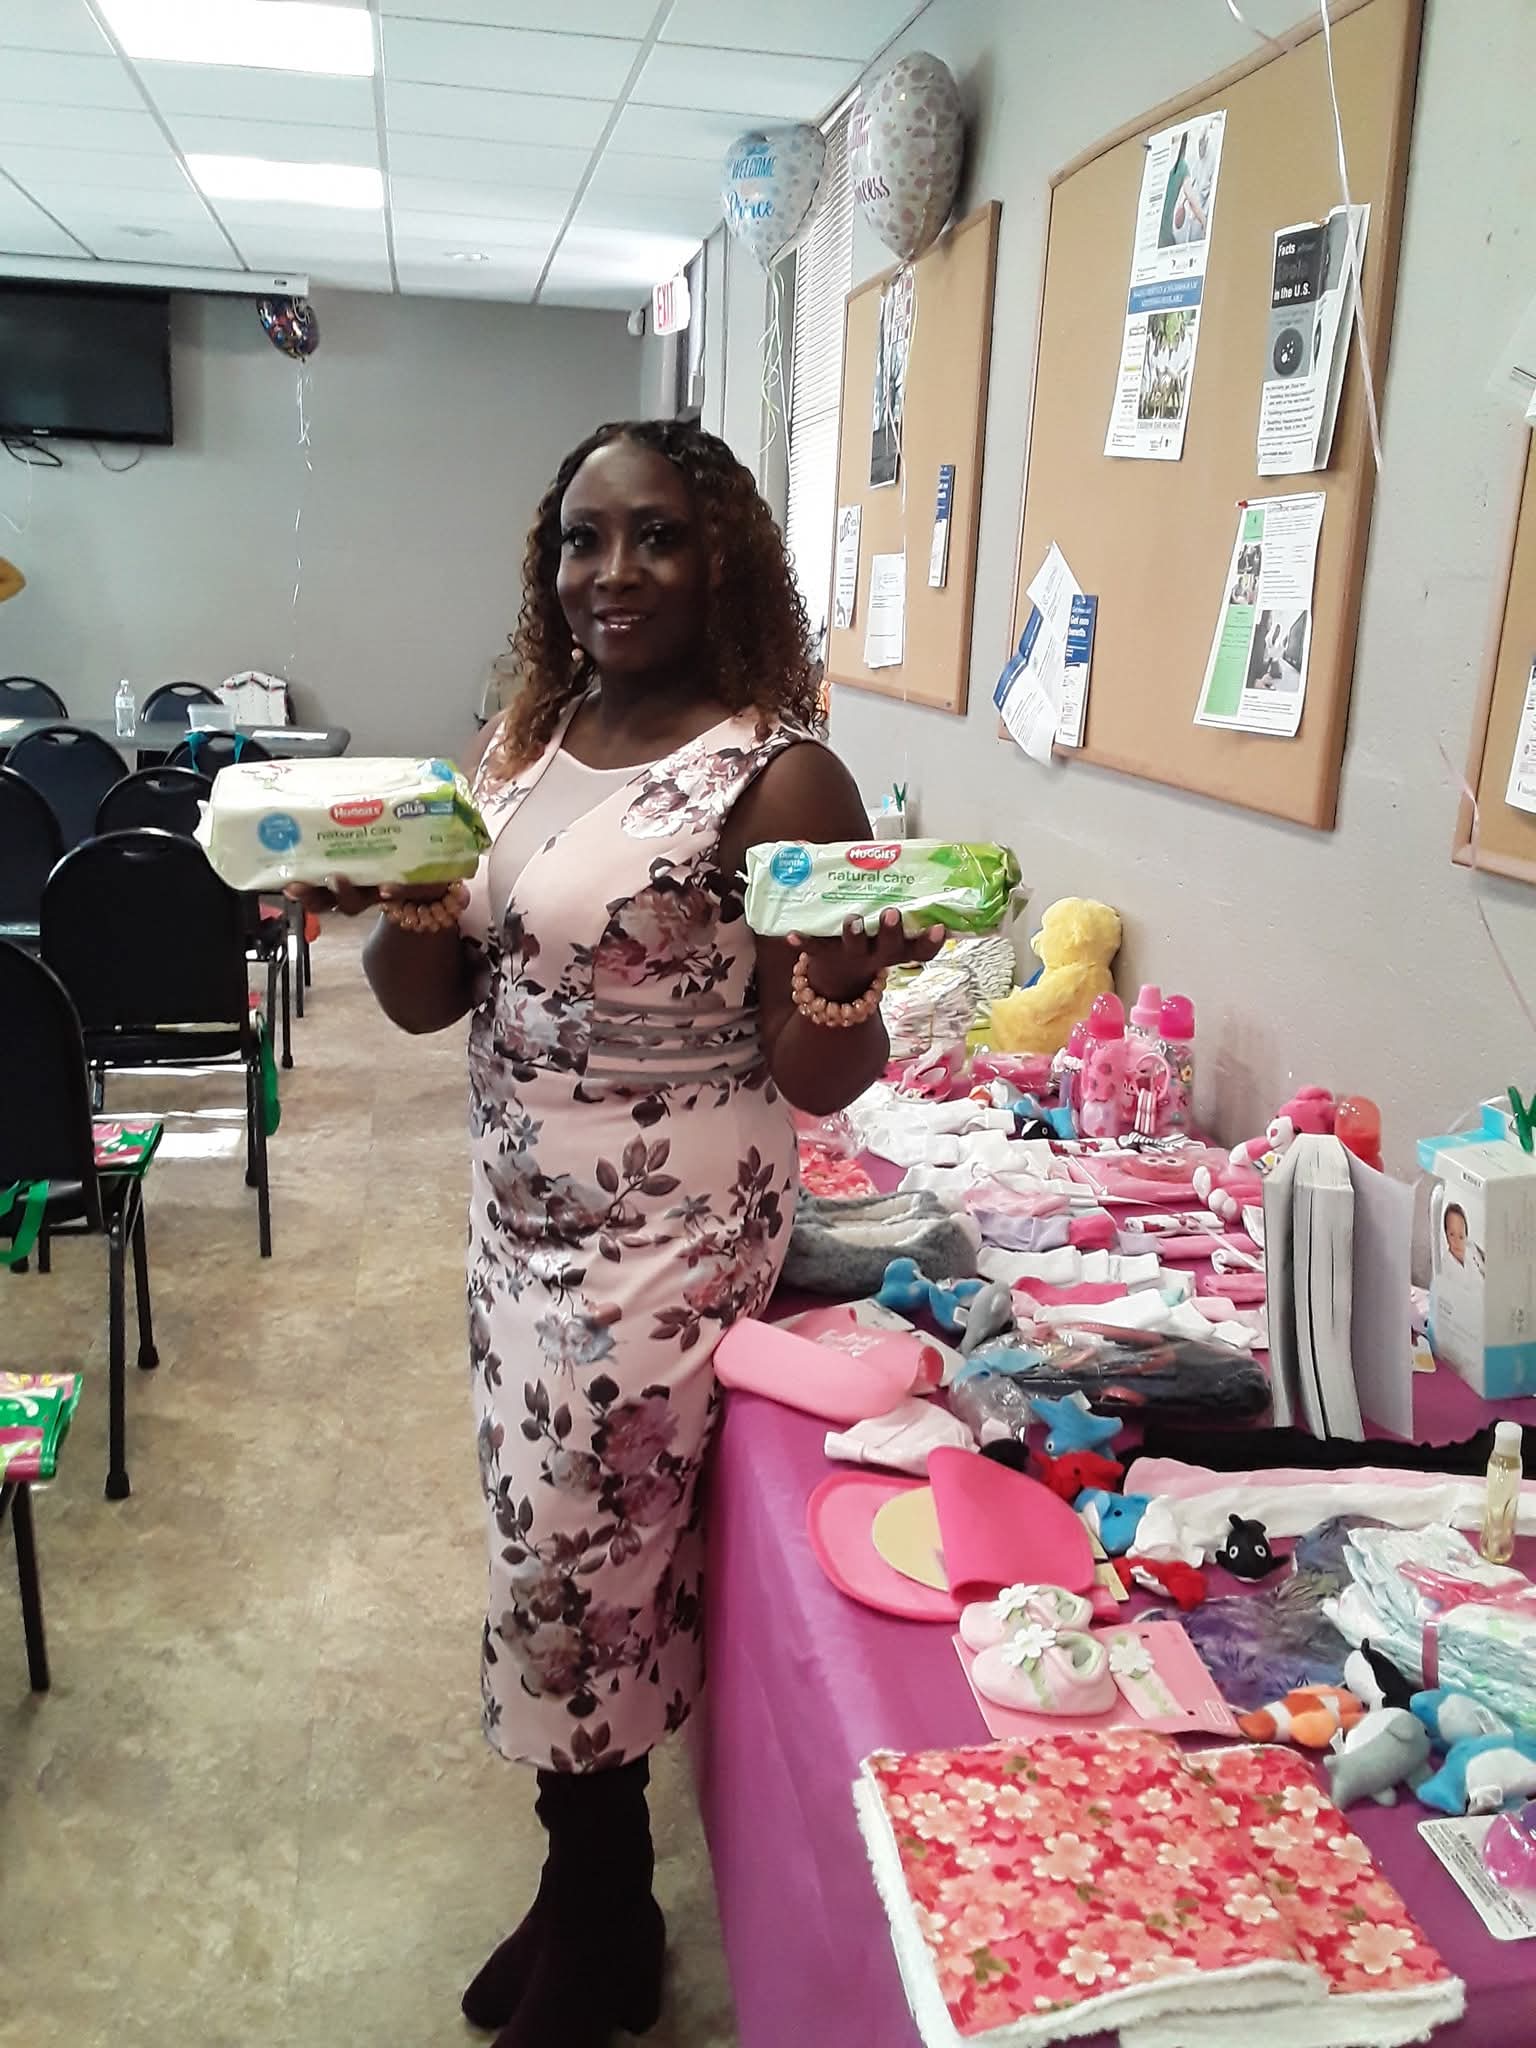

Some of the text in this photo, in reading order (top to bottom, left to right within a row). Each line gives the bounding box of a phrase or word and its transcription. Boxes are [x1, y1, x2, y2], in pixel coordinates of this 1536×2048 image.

[730, 155, 776, 179] WELCOME
[727, 191, 775, 219] Prince
[1278, 241, 1296, 257] Facts
[1280, 286, 1293, 299] the
[1294, 282, 1311, 297] U.S.
[656, 280, 674, 329] EXIT
[396, 799, 425, 819] plus
[849, 848, 897, 860] HUGGIES
[827, 868, 915, 885] natural care
